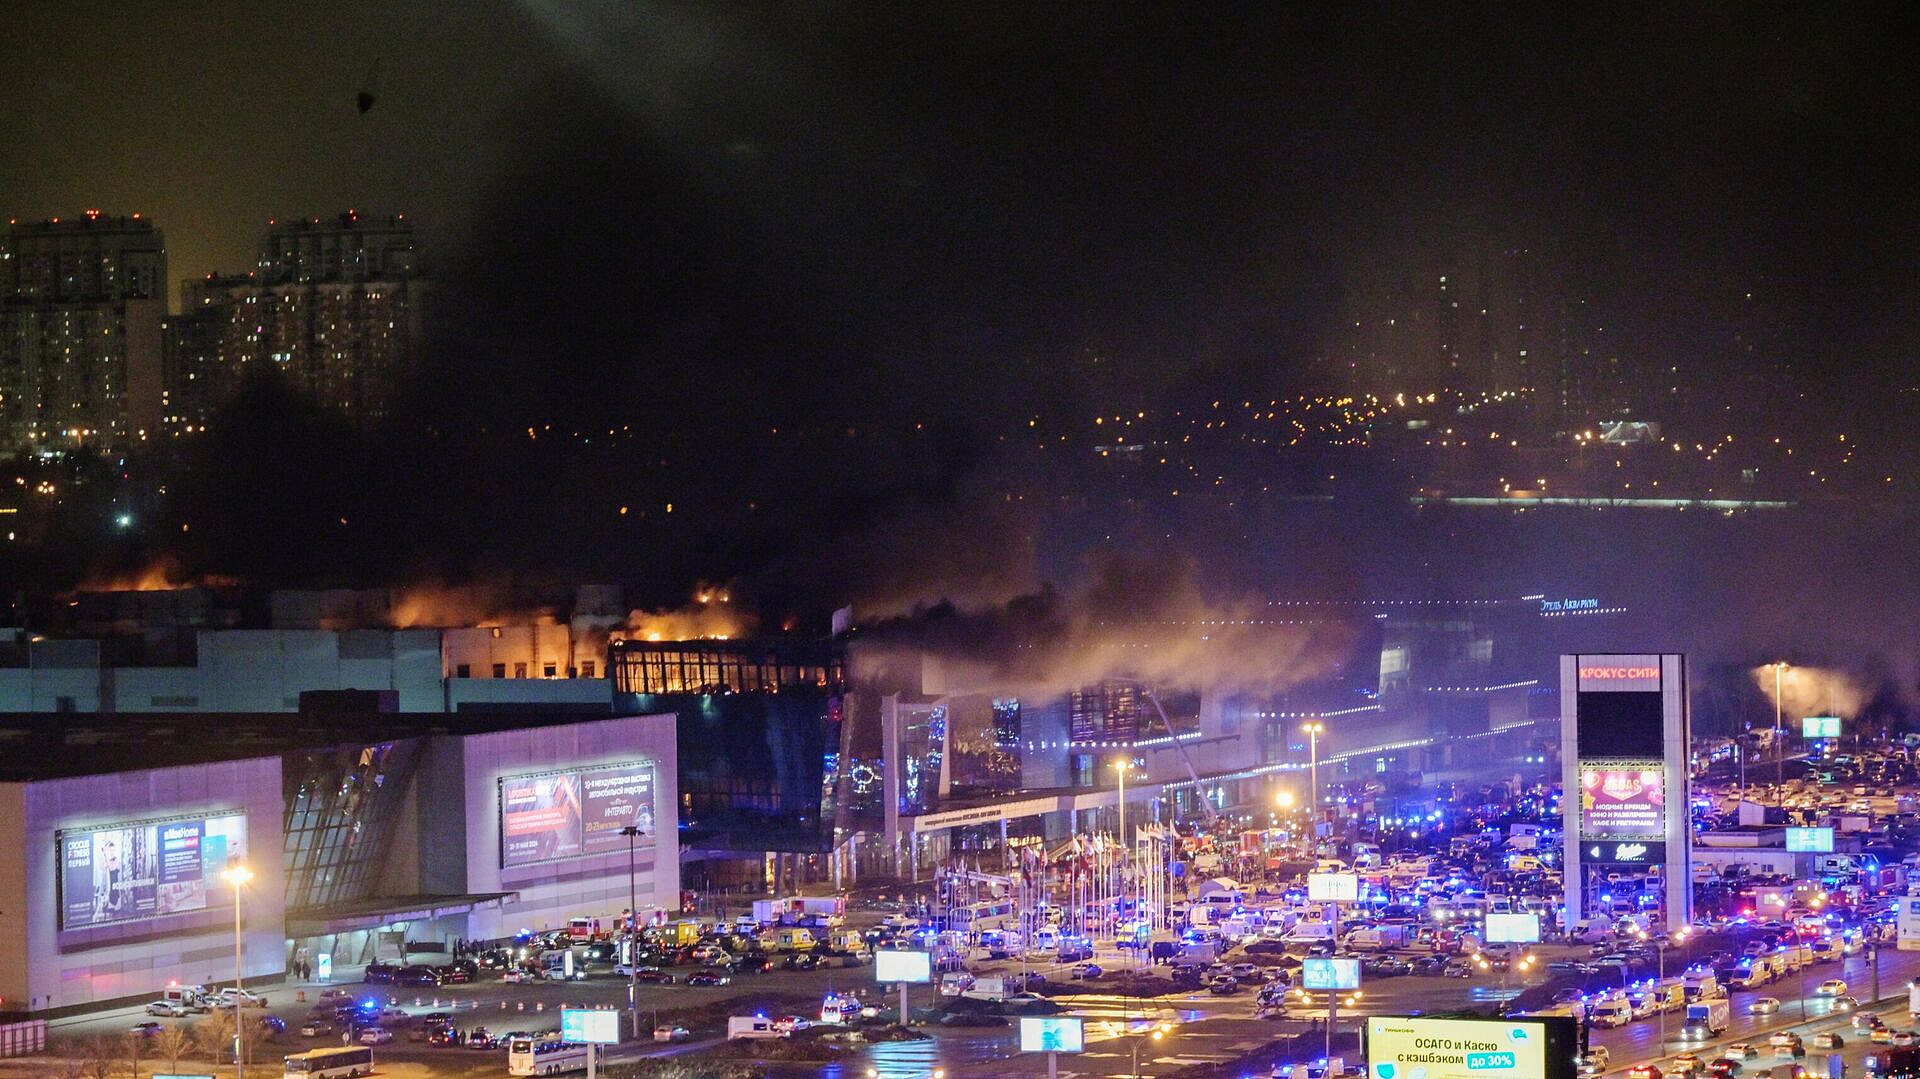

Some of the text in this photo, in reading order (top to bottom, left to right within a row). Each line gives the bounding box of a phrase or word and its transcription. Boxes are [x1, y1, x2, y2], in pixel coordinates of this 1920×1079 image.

[1580, 667, 1660, 680] КРОКУС СИТИ
[1604, 779, 1640, 790] VEGAS
[1415, 1038, 1498, 1051] ОСАГО и Каско
[1398, 1053, 1512, 1068] с кэшбэком до 30%
